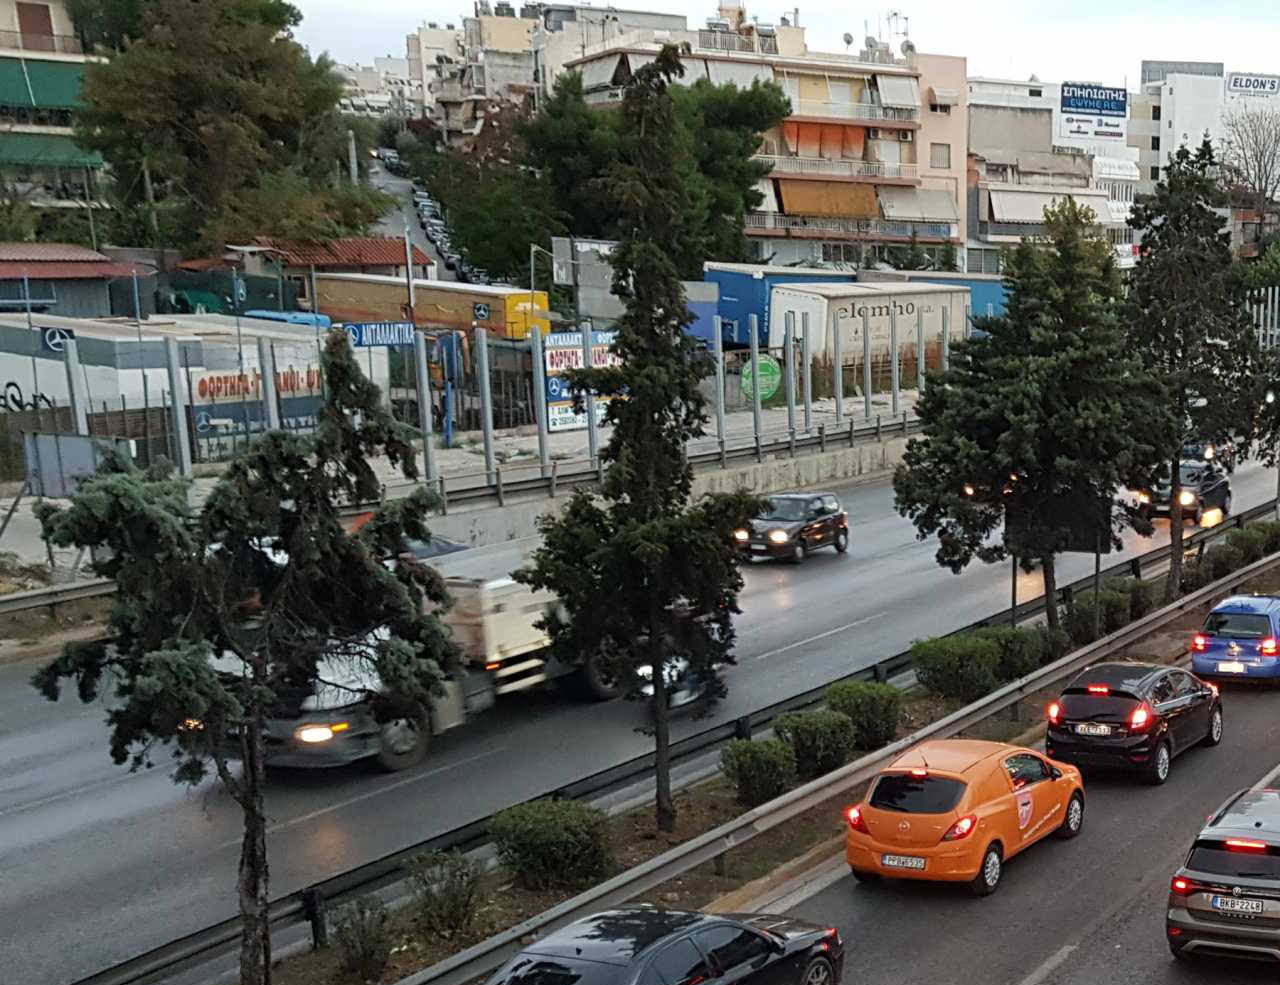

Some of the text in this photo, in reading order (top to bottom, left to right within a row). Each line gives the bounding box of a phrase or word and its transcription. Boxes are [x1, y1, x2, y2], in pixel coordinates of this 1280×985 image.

[1232, 77, 1277, 90] ELDON'S
[361, 323, 416, 346] ΑΝΤΑΛΛΑΚΤΙΚΑ
[198, 374, 251, 398] ΦΟΡΤΗΓΑ
